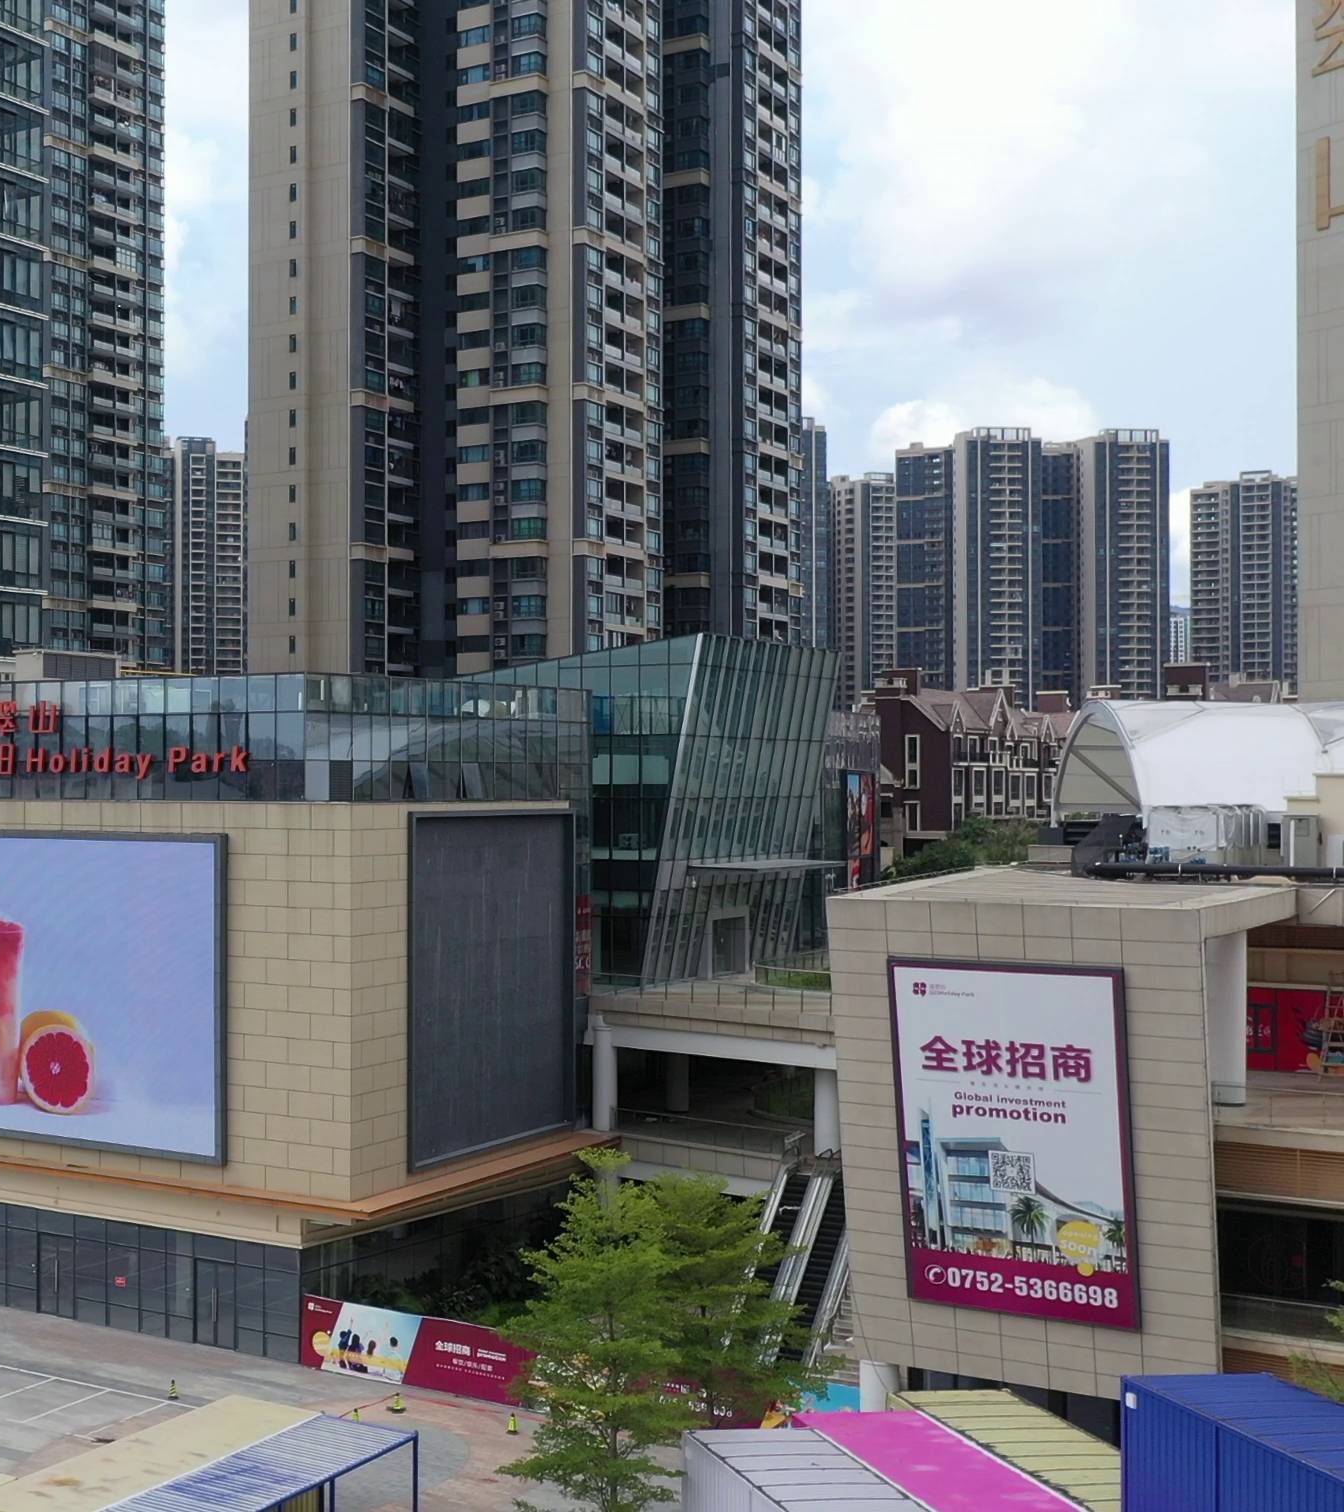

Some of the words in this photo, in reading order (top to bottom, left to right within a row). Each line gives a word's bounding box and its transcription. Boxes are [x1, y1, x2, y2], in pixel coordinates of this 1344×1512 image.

[25, 745, 154, 779] Holiday
[167, 745, 250, 774] Park
[919, 1035, 1092, 1083] 全球招商
[952, 1102, 1066, 1124] promotion
[954, 1090, 992, 1103] Global
[996, 1095, 1066, 1109] investment
[946, 1266, 1119, 1309] 0752-5366698
